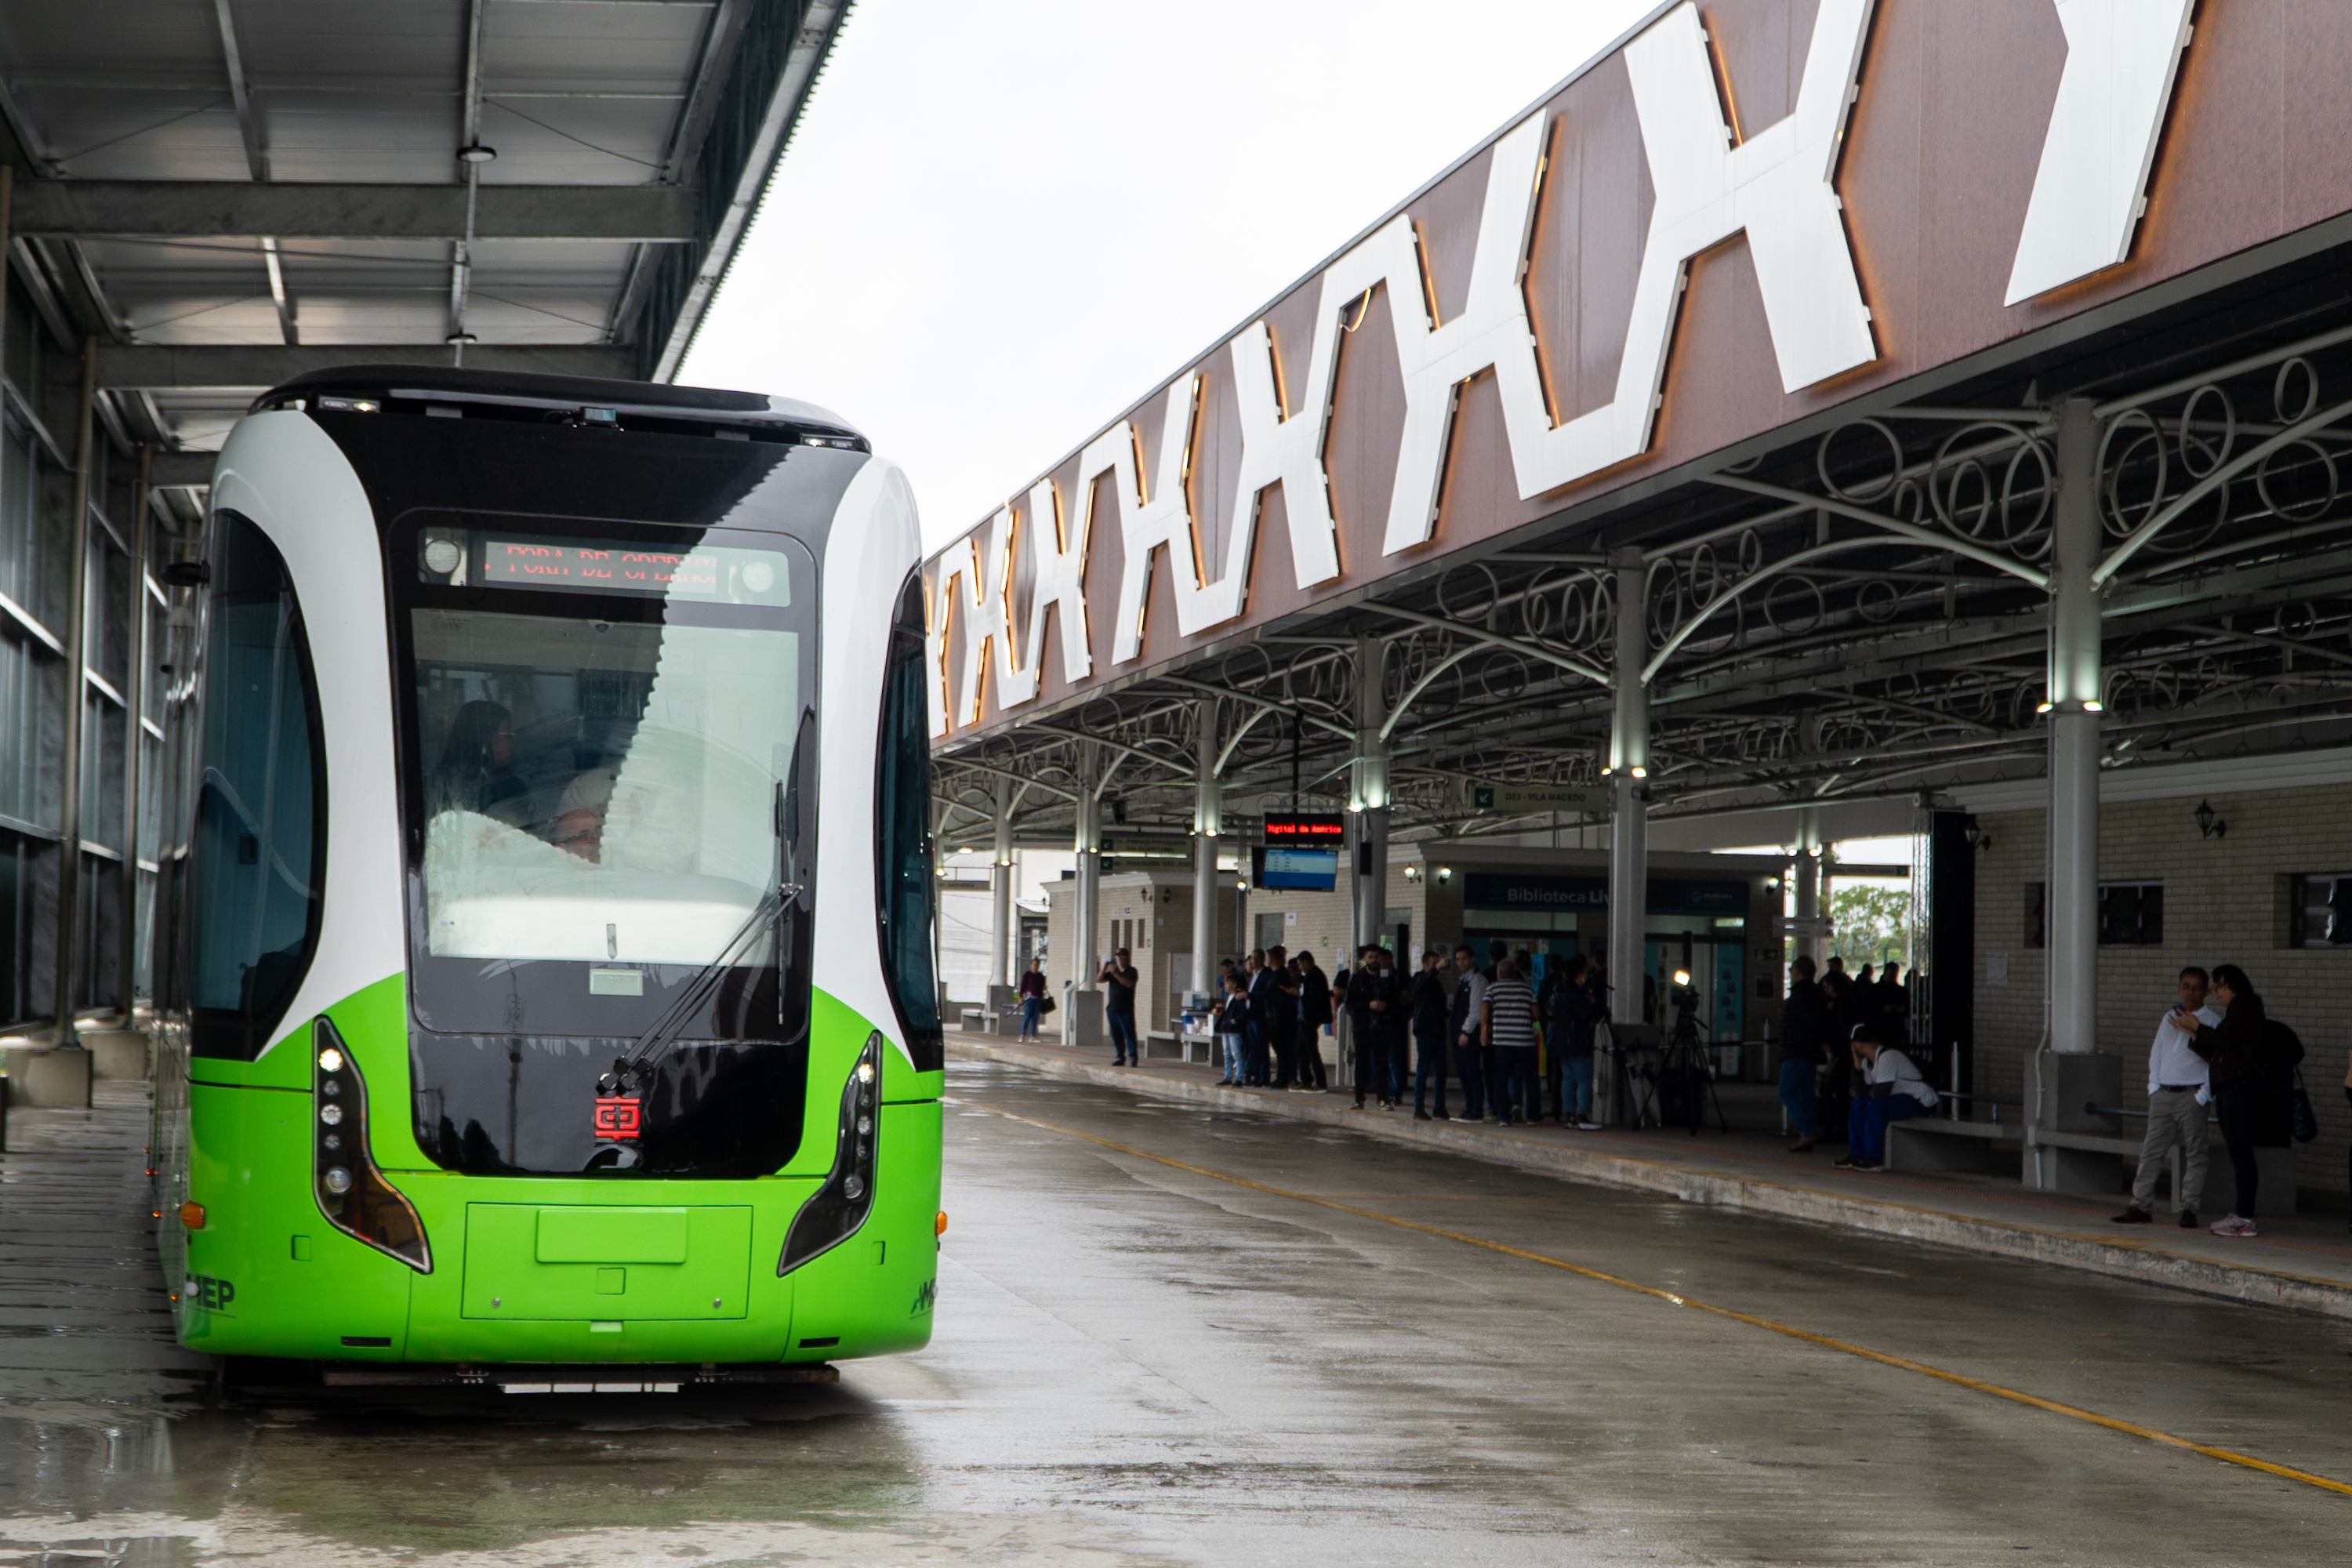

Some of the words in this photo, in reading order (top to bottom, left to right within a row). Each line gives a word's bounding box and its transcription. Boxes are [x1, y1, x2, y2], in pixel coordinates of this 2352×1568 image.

[507, 546, 568, 575] FORA
[580, 551, 612, 579] DE
[1528, 793, 1546, 801] VILA
[1548, 793, 1586, 802] MACEDO
[1508, 887, 1585, 903] Biblioteca
